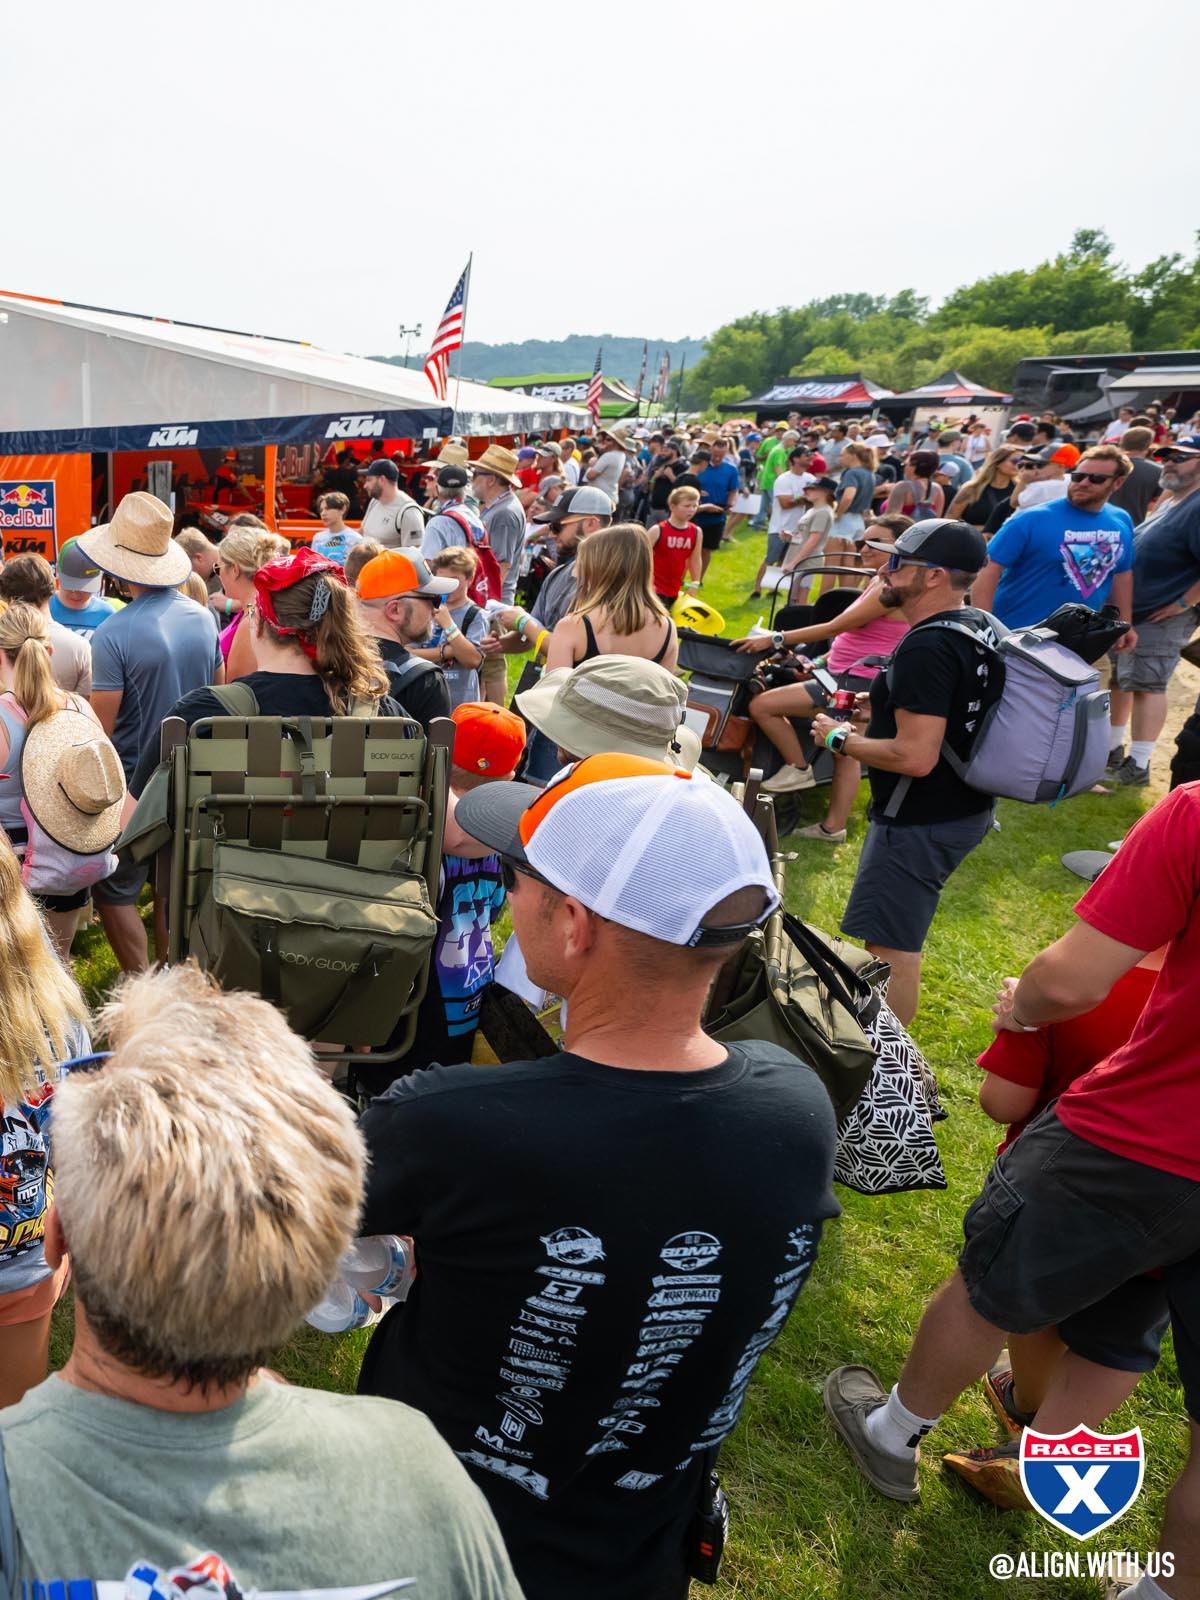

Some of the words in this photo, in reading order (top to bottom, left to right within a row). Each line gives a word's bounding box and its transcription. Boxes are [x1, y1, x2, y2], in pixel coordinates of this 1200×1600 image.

[324, 415, 385, 438] KTM
[148, 426, 199, 447] KTM
[25, 508, 53, 527] Bull
[5, 537, 46, 553] KTM
[667, 536, 692, 549] USA
[370, 752, 389, 760] BODY
[391, 752, 416, 760] GLOVE
[279, 950, 314, 966] BODY
[315, 957, 361, 974] GLOVE
[663, 1288, 719, 1301] NORTHGATE
[510, 1325, 555, 1344] JetBoy
[453, 1448, 550, 1496] AMA
